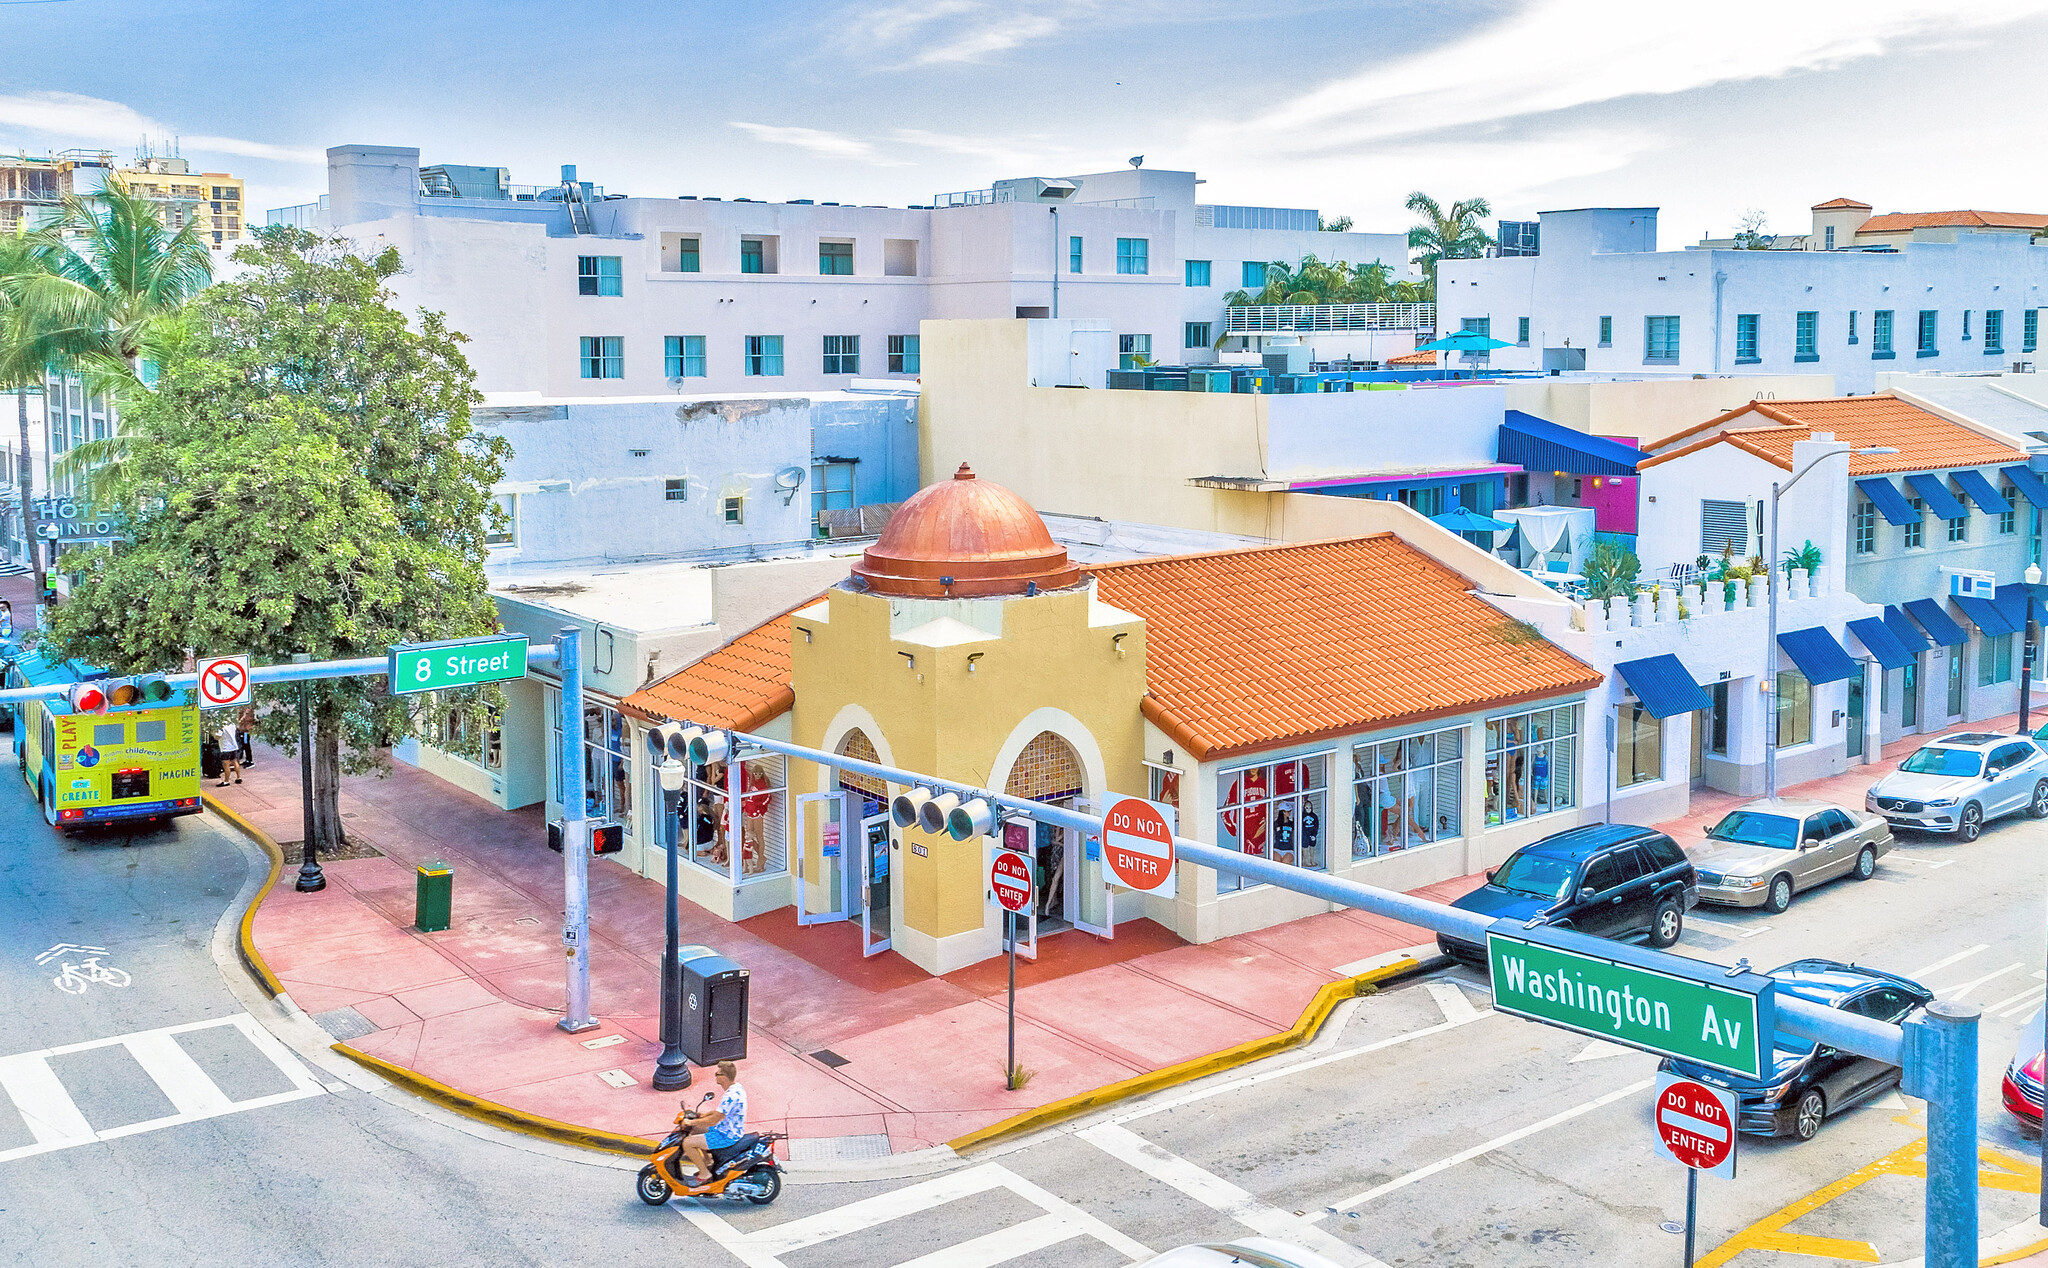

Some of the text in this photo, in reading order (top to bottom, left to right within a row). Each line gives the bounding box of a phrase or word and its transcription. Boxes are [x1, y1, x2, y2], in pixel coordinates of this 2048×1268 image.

[40, 501, 122, 519] HOTE
[36, 521, 119, 537] CINTO
[415, 651, 509, 682] 8 Street
[62, 720, 77, 750] PLAY
[181, 708, 193, 744] LEARN
[125, 747, 163, 756] children's
[159, 768, 196, 780] IMAGINE
[62, 790, 99, 801] CREATE
[1113, 813, 1162, 836] DO NOT
[998, 861, 1026, 877] DO NOT
[1118, 854, 1158, 876] ENTER
[1000, 888, 1023, 902] ENTER
[1502, 954, 1742, 1049] Washington Av
[1668, 1092, 1722, 1120] DO NOT
[1671, 1130, 1715, 1157] ENTER
